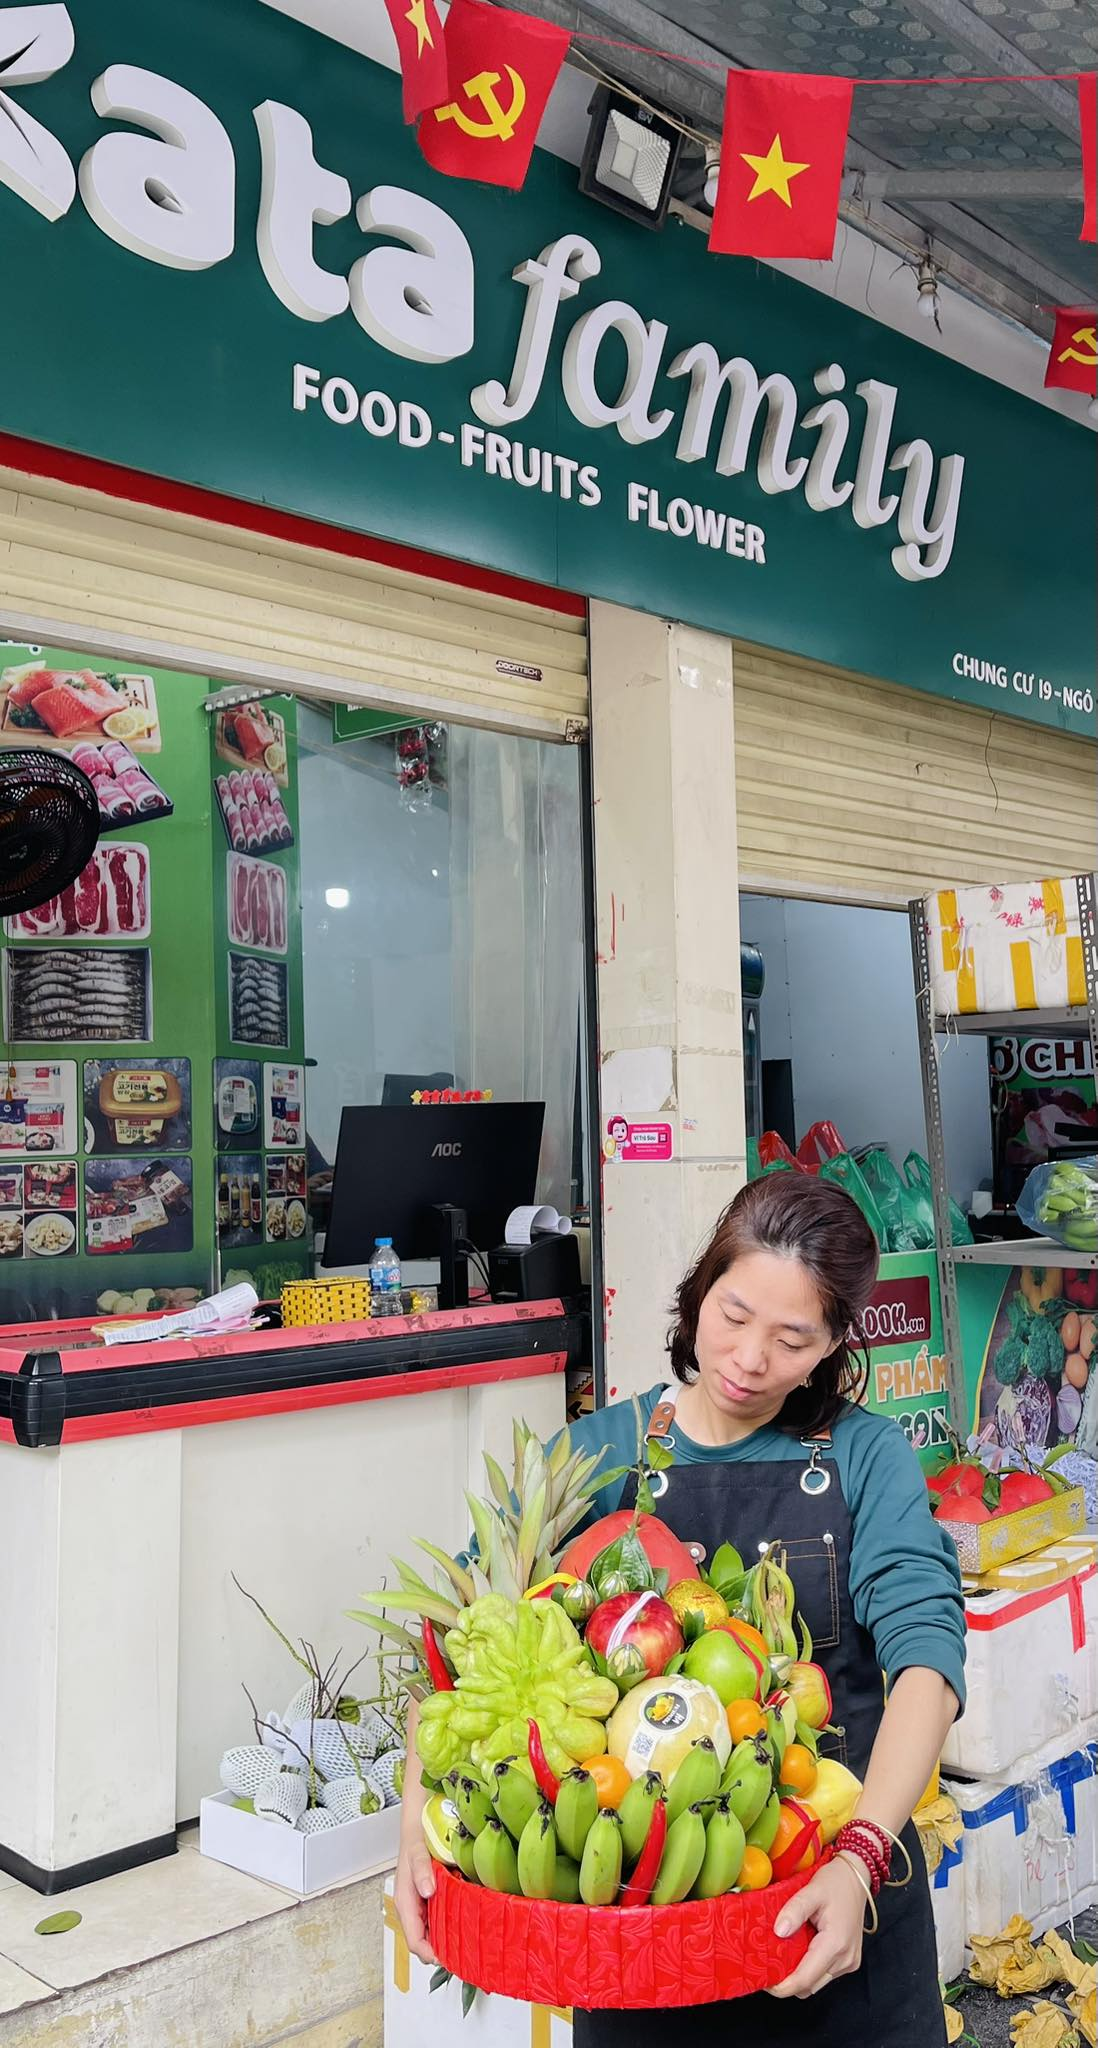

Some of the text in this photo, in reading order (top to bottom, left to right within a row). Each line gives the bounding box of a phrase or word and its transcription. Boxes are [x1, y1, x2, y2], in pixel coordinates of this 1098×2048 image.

[470, 233, 965, 582] family
[627, 481, 767, 564] FLOWER
[952, 652, 1008, 688] CHUNG
[1012, 671, 1035, 696] CƯ
[431, 1142, 462, 1158] AOC
